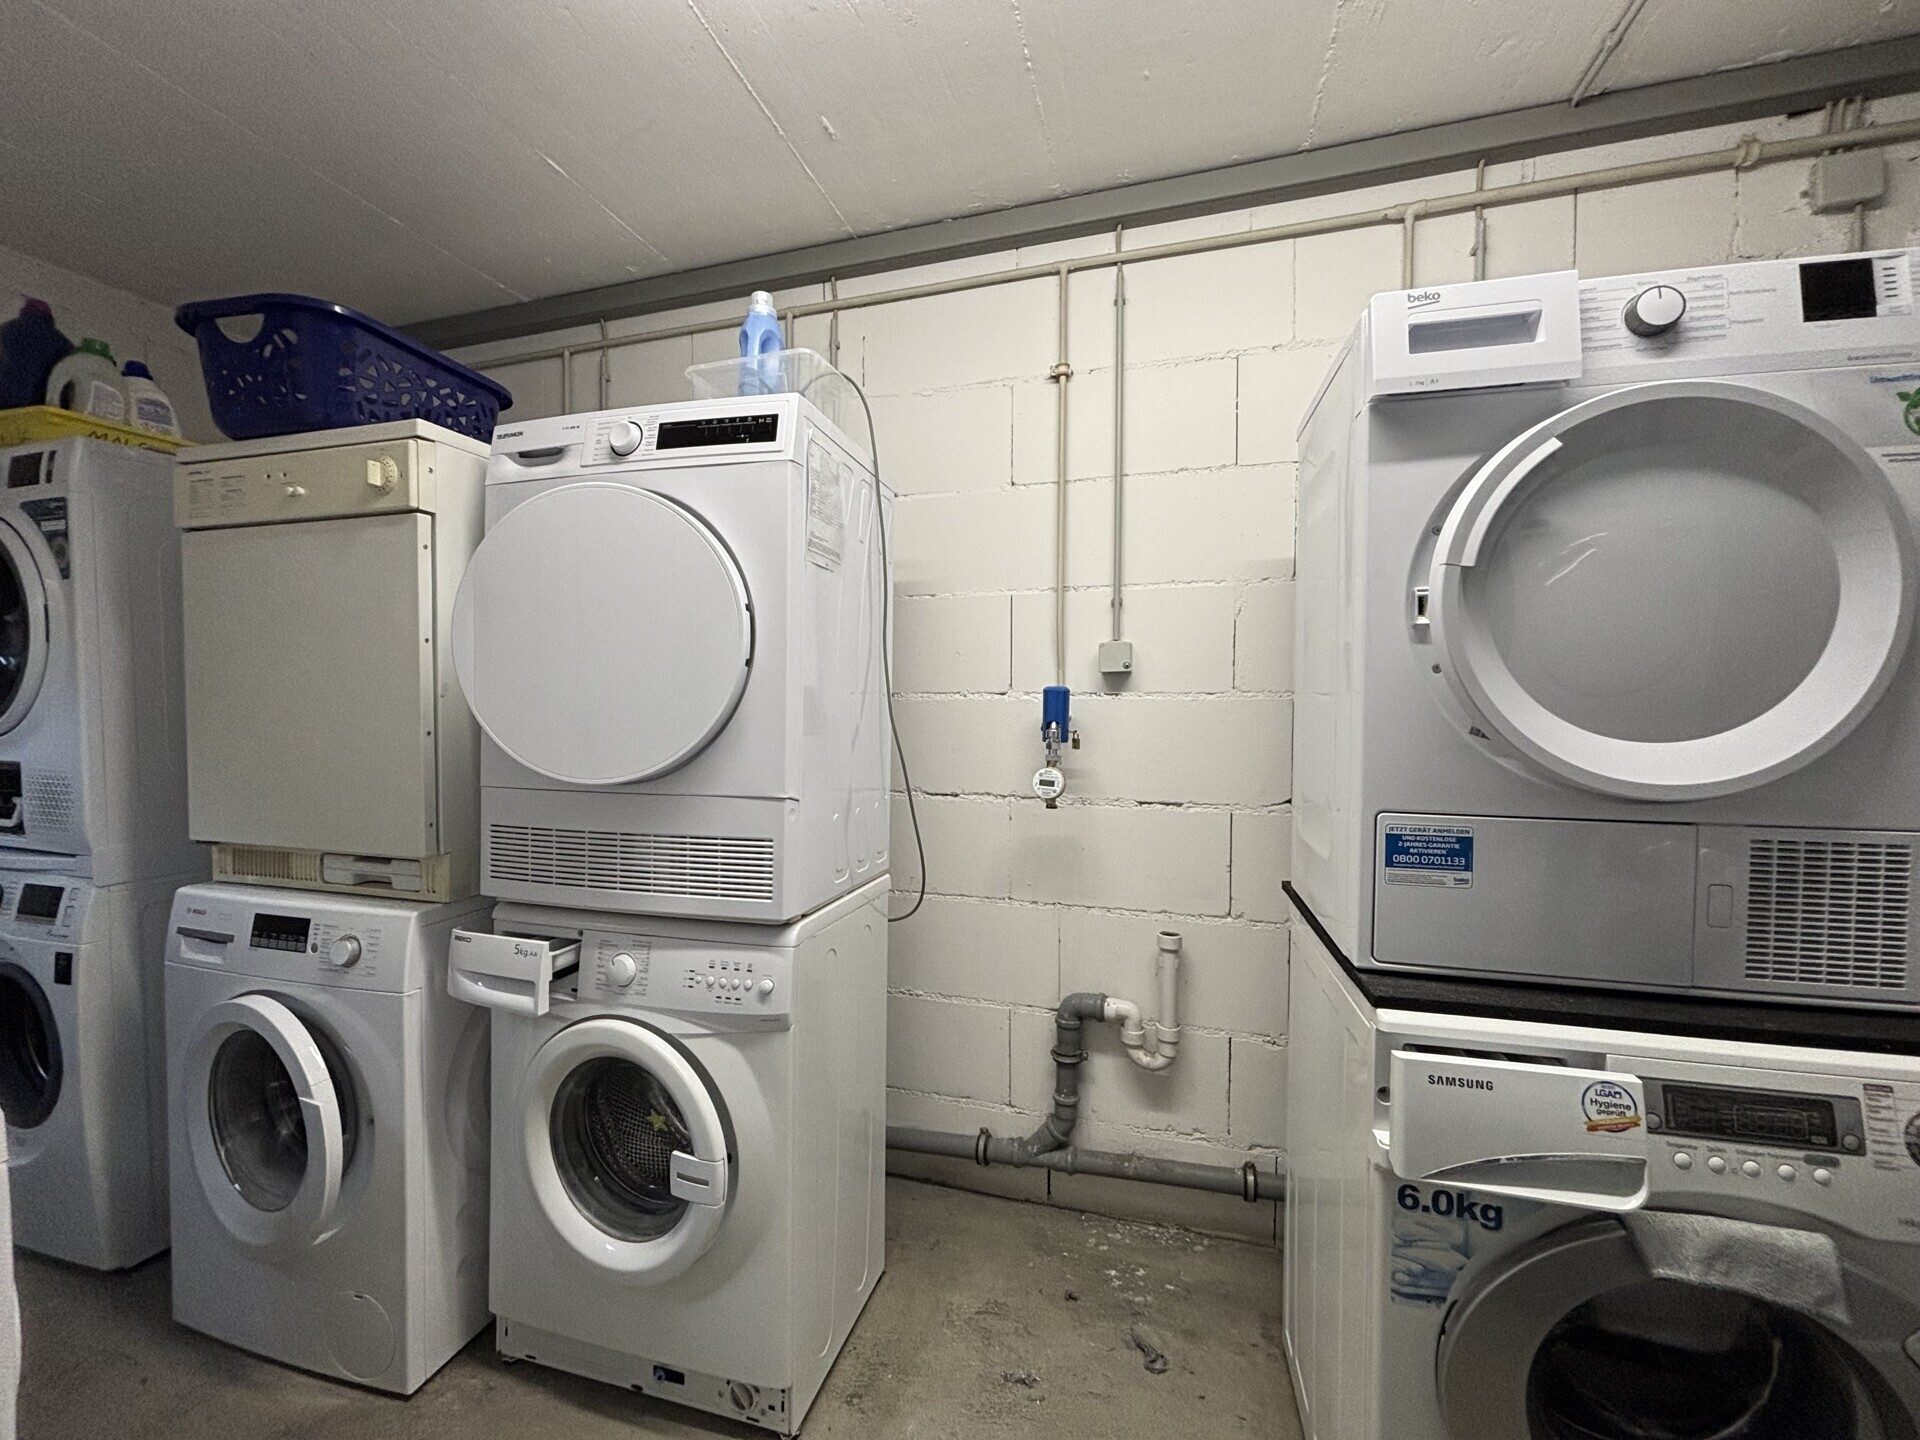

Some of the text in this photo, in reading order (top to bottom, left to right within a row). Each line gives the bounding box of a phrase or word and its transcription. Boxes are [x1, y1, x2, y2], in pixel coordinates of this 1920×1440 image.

[1407, 291, 1441, 303] beko
[1409, 826, 1431, 834] GERÄT
[1398, 841, 1460, 849] 2-JAHRES-GARANTIE
[1393, 854, 1465, 866] 0800 0701133
[514, 943, 529, 957] 5kg
[1428, 1074, 1494, 1091] SAMSUNG
[1590, 1097, 1632, 1110] Hygiene
[1596, 1108, 1626, 1118] geprüft
[1397, 1184, 1504, 1231] 6.0kg
